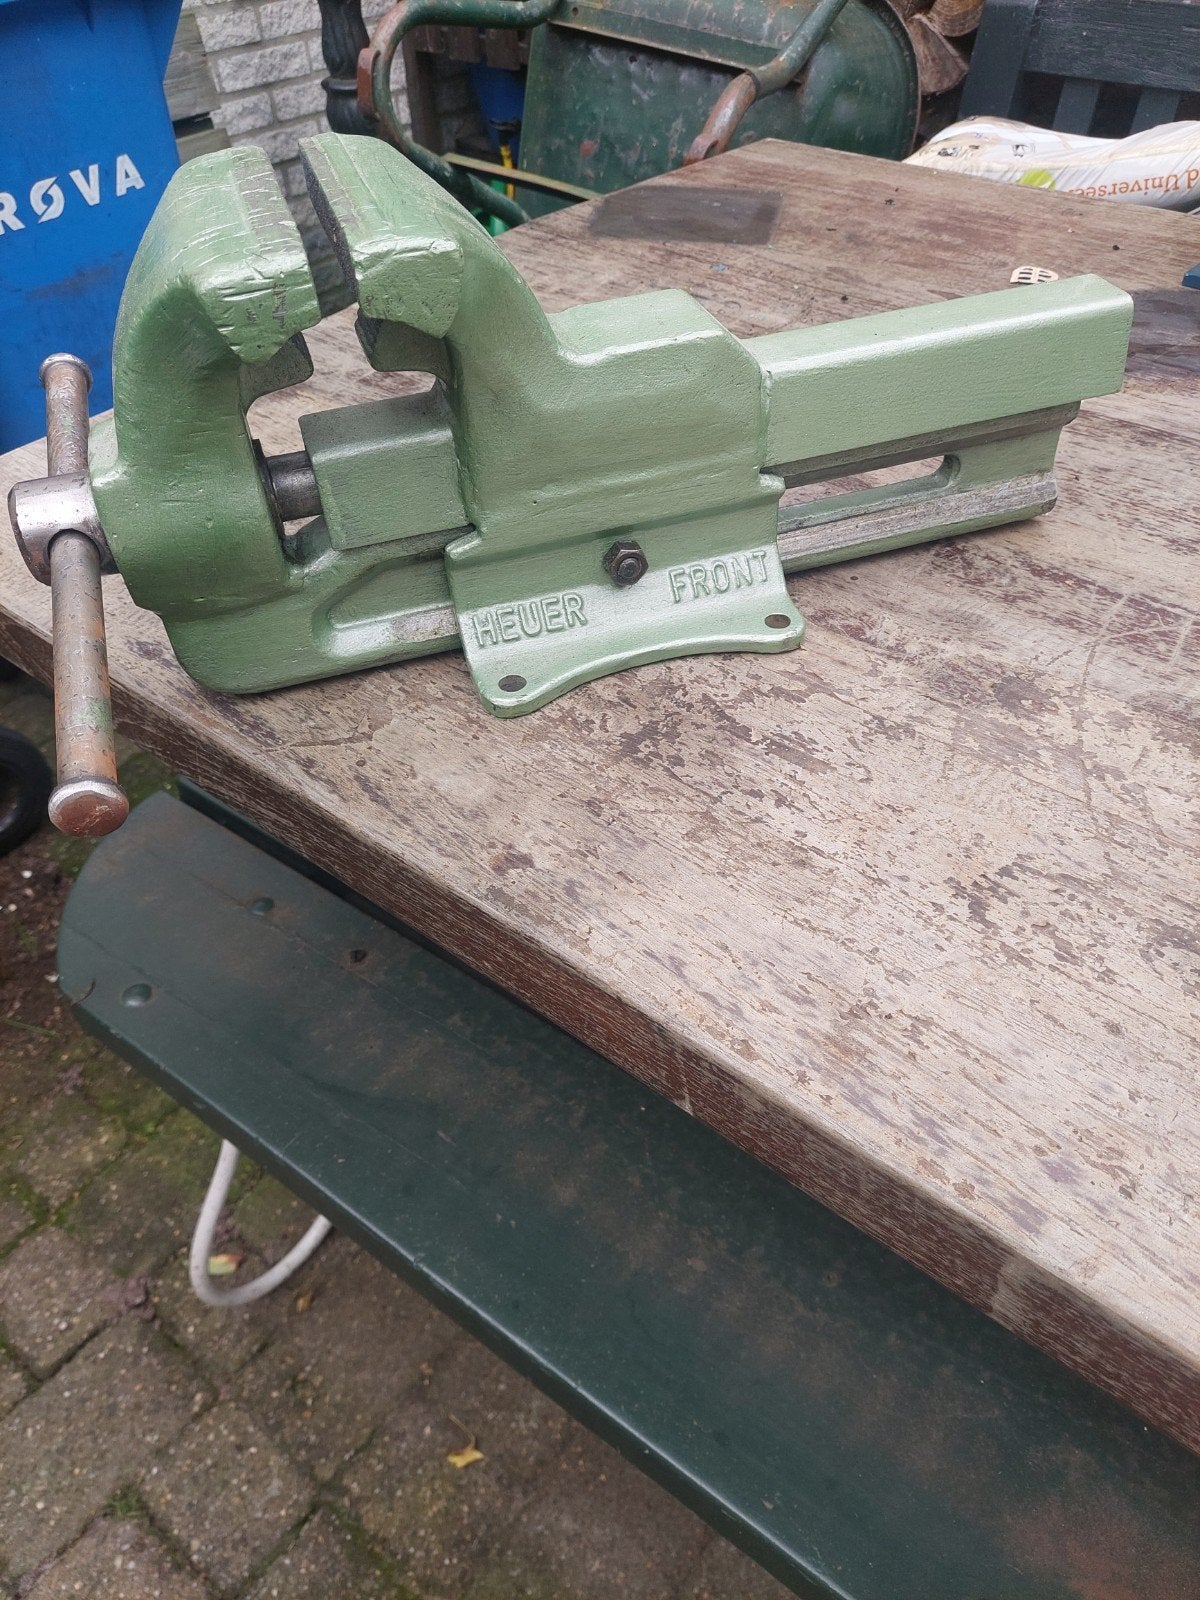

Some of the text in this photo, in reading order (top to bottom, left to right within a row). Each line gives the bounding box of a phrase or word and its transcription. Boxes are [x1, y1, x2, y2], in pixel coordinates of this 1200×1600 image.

[1068, 174, 1180, 198] Universee
[471, 550, 768, 648] HEUER FRONT
